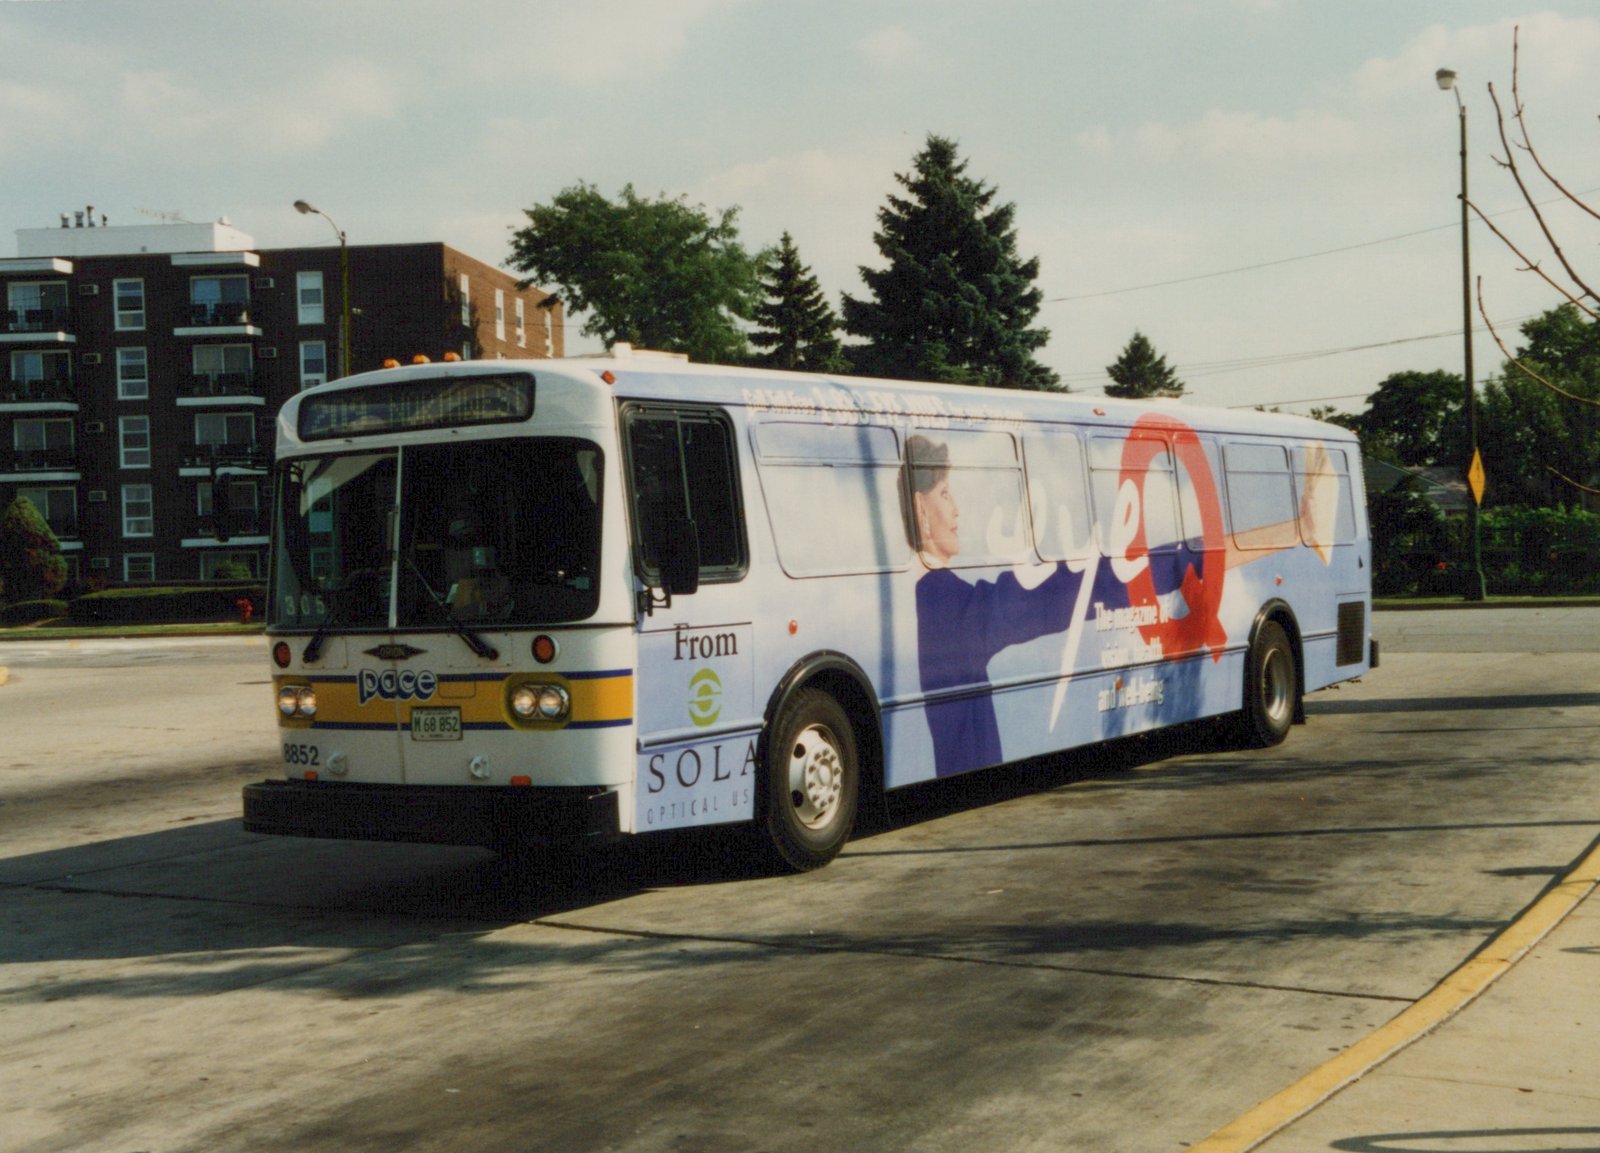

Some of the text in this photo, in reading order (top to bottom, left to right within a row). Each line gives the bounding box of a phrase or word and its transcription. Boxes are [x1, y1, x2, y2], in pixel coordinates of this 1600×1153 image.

[673, 623, 738, 661] From
[357, 668, 437, 704] pace
[284, 744, 319, 766] 8852
[648, 739, 756, 793] SOLA
[647, 794, 718, 824] OPTICAL
